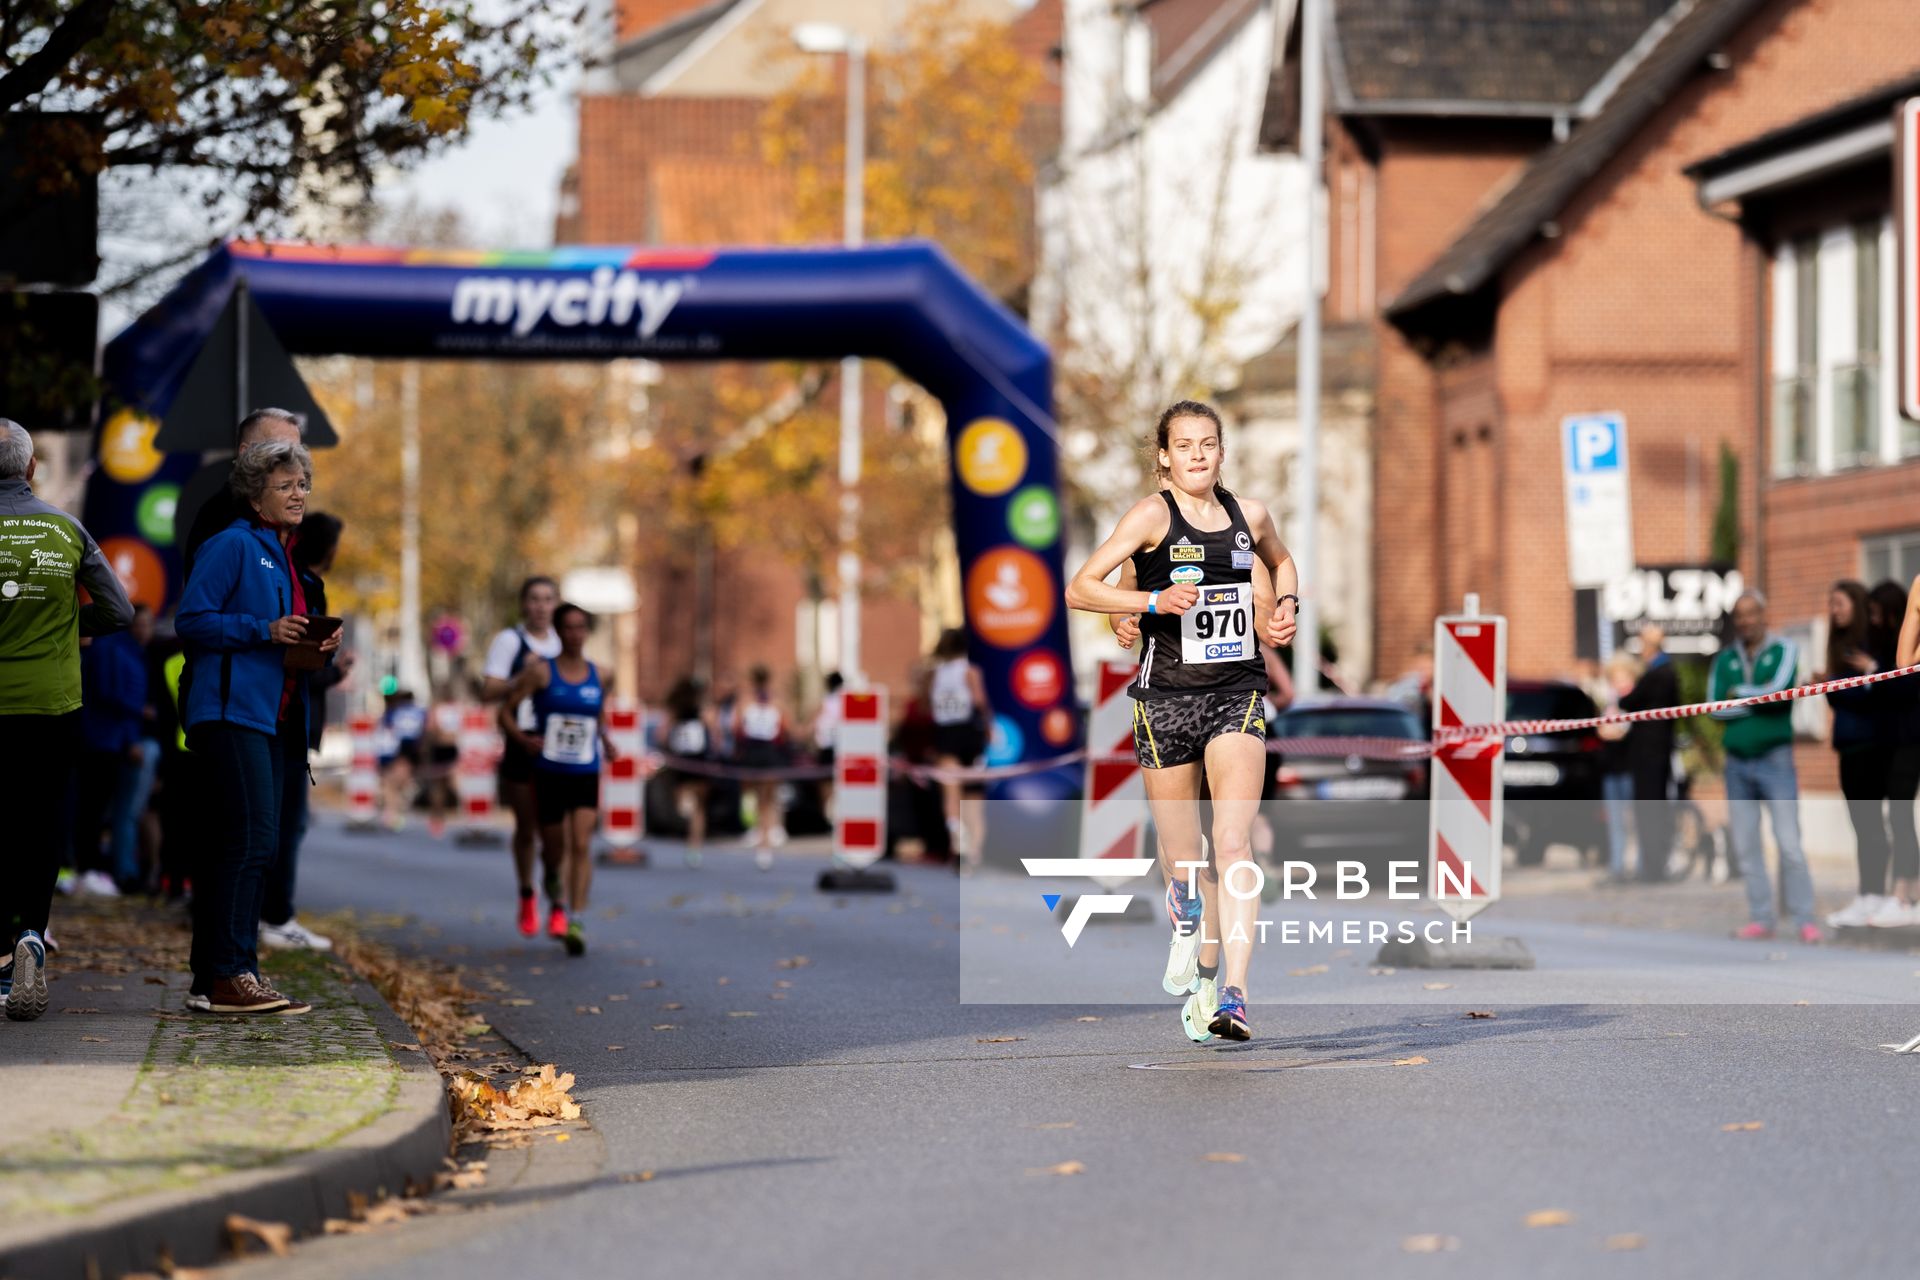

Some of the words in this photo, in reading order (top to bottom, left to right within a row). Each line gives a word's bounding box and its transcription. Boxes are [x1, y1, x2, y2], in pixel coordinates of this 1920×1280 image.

[450, 267, 683, 338] mycity
[1576, 422, 1613, 471] P
[30, 549, 63, 559] Stephan
[36, 557, 72, 569] Vollbrecht
[1223, 592, 1237, 602] GLS
[1195, 608, 1246, 639] 970
[1221, 644, 1241, 653] PLAN
